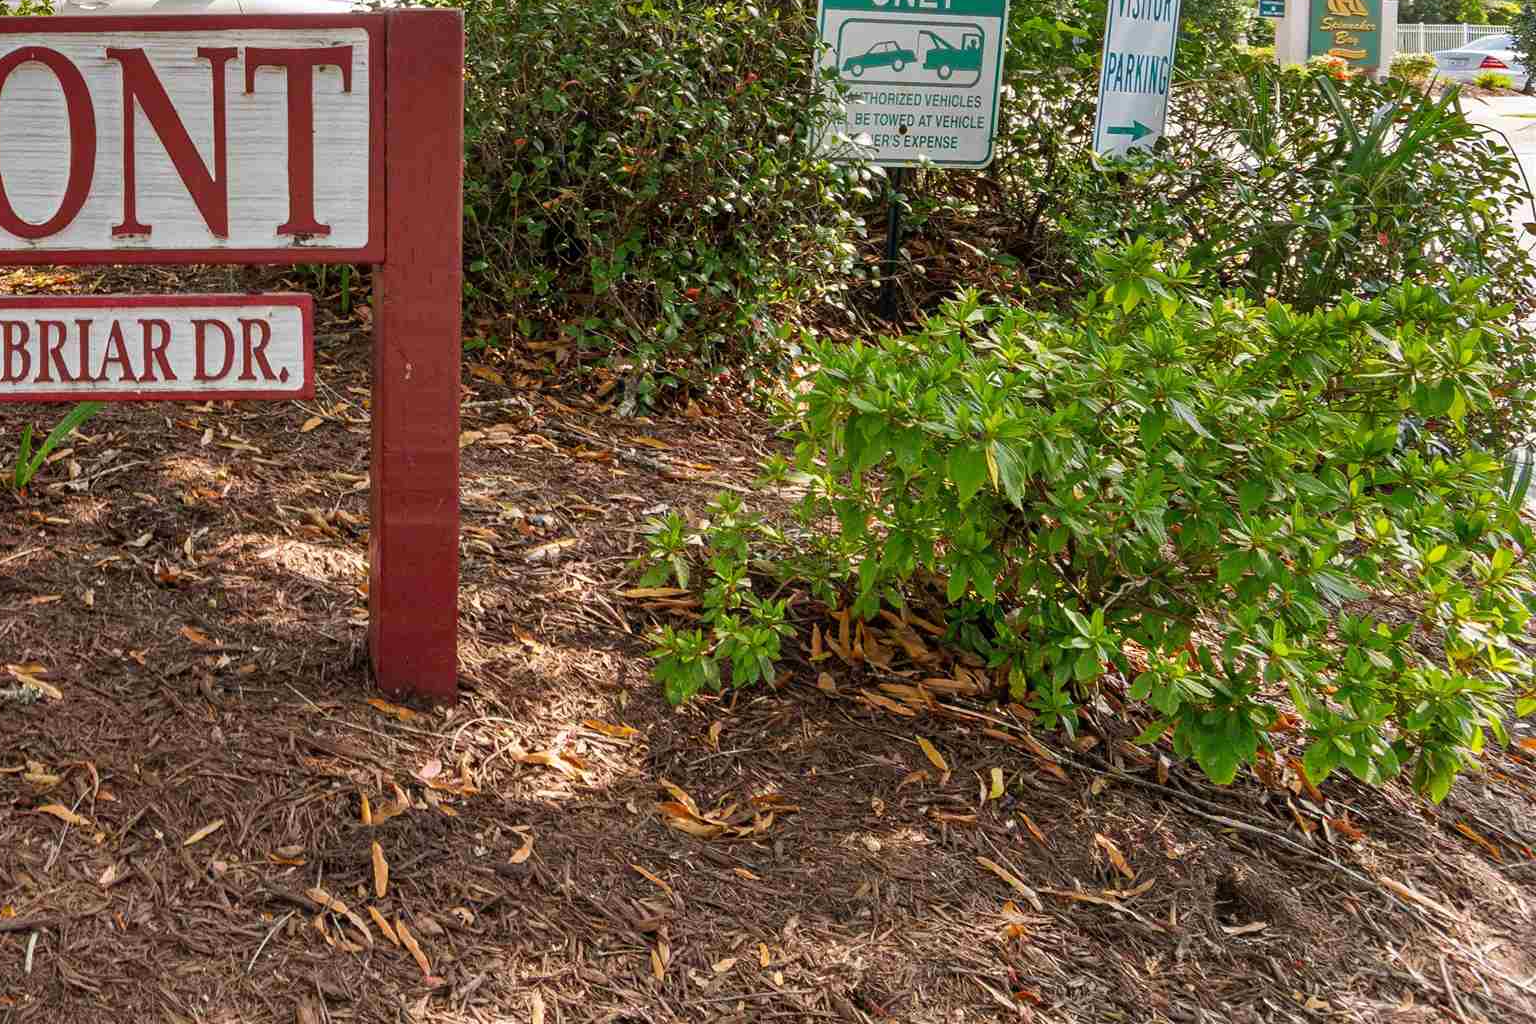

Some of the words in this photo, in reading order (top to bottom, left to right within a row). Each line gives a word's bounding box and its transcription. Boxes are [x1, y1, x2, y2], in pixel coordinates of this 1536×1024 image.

[1106, 52, 1169, 95] PARKING
[925, 95, 981, 108] VEHICLES
[855, 113, 870, 125] BE
[874, 113, 914, 126] TOWED
[918, 115, 934, 127] AT
[935, 116, 984, 129] VEHICLE
[904, 135, 958, 149] EXPENSE
[190, 318, 290, 383] DR.
